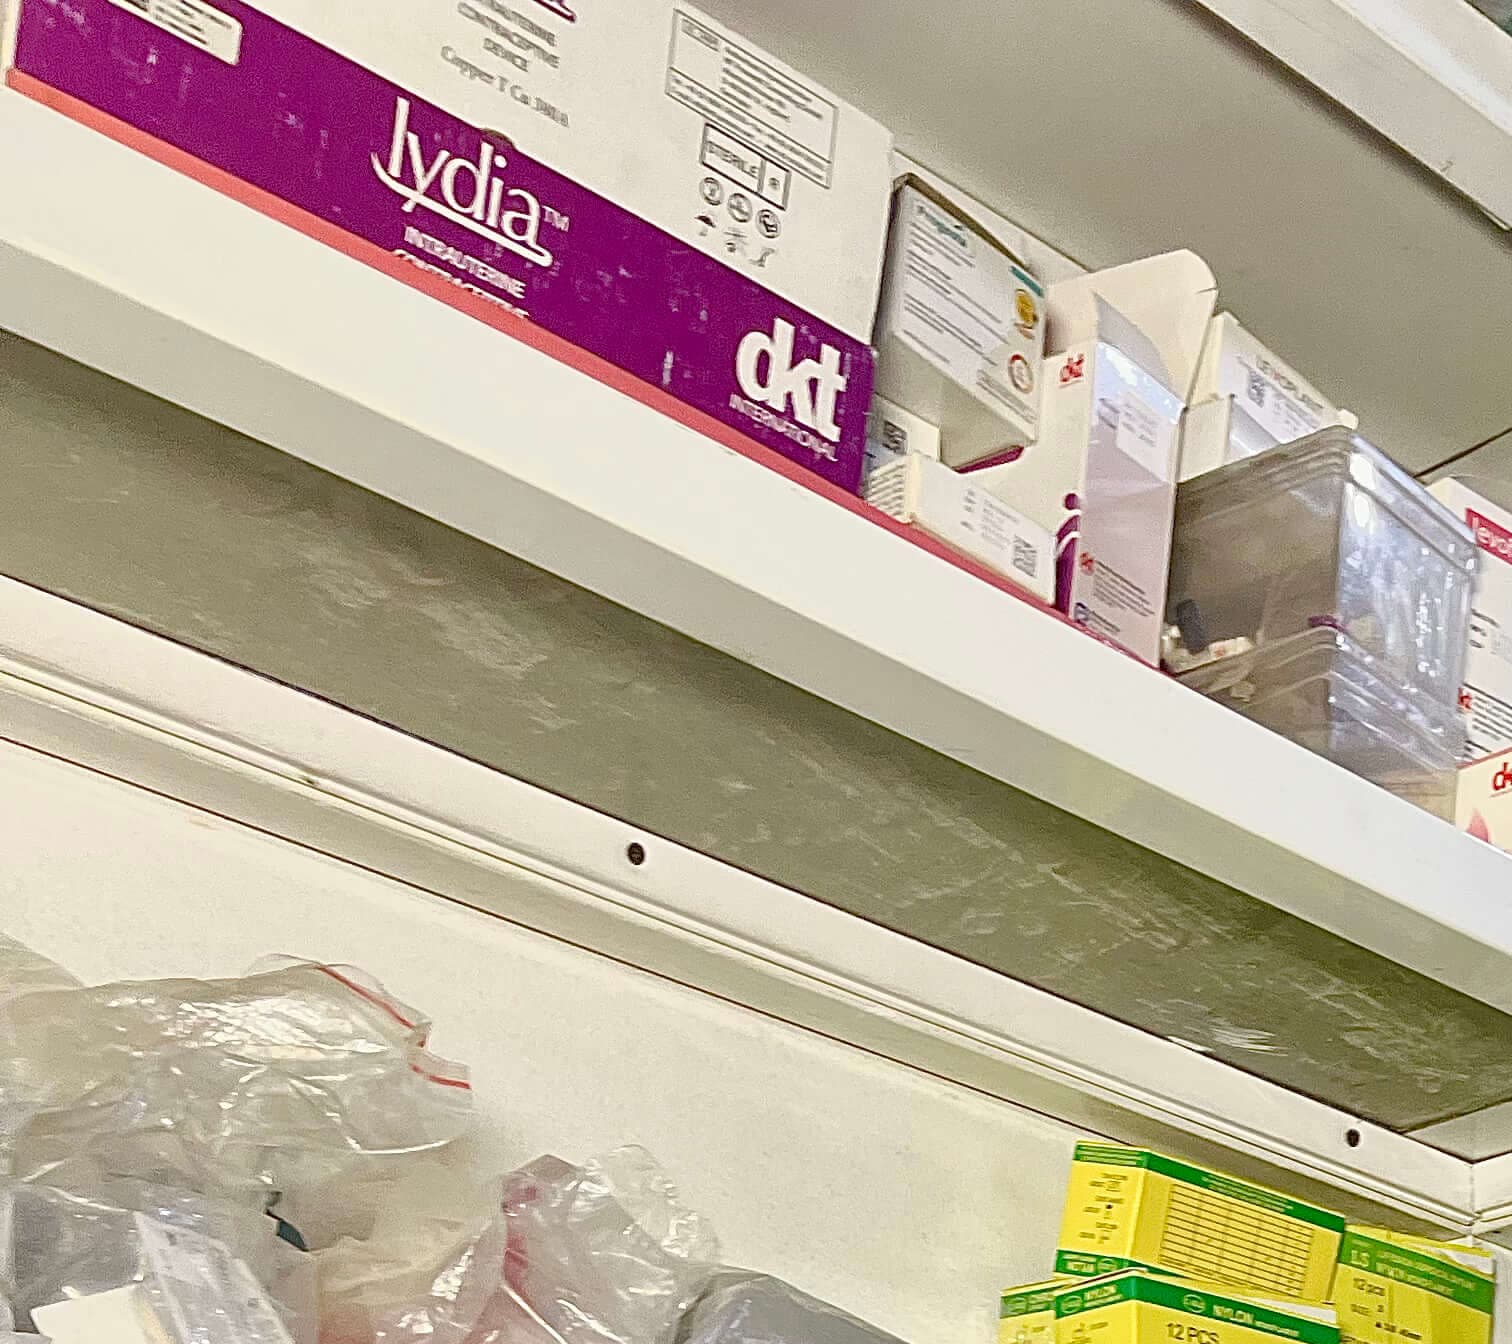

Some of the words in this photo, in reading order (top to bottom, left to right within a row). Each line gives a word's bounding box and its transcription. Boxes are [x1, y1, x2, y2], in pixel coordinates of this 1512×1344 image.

[375, 95, 546, 258] lydia
[735, 317, 847, 442] dkt
[1166, 1322, 1184, 1341] 12
